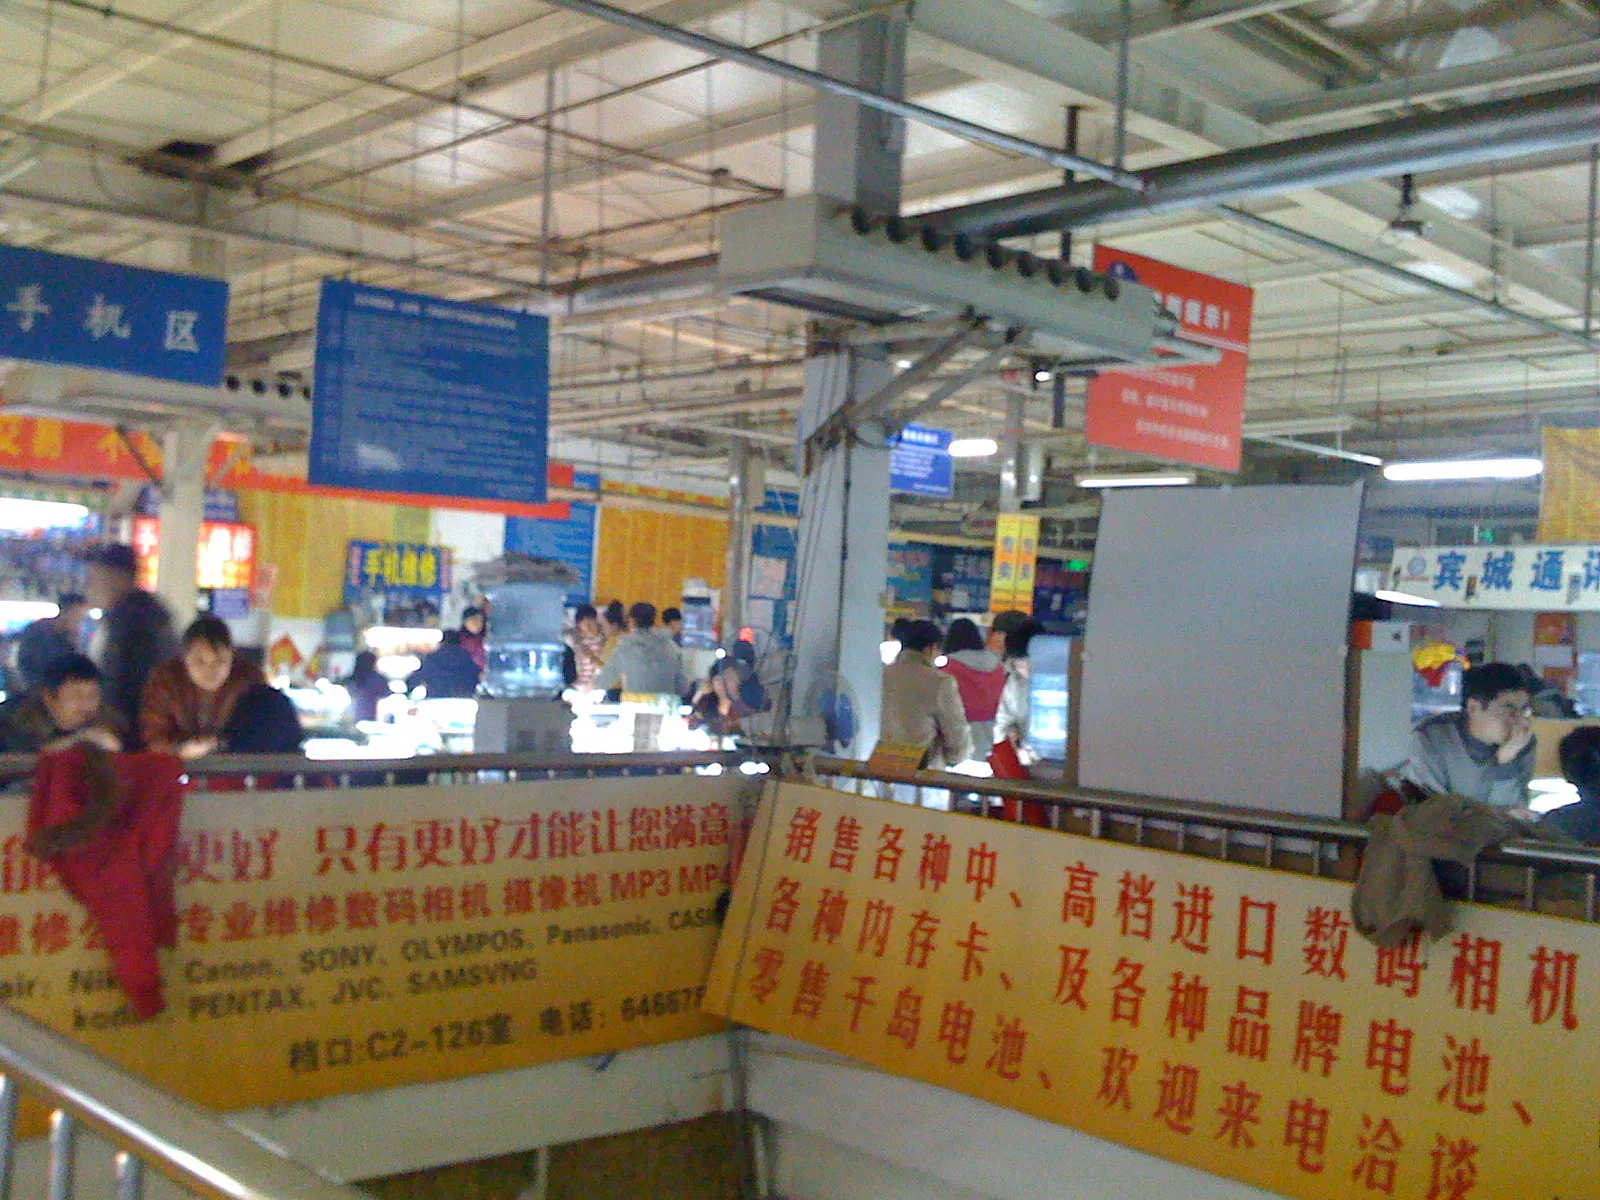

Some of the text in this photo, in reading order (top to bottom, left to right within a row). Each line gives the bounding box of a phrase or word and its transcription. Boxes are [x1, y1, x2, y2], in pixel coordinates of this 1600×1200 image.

[6, 283, 200, 352] 手机区
[315, 802, 731, 876] 只有更好才能让您满意
[504, 873, 601, 915] 摄像机
[610, 869, 671, 901] MP3
